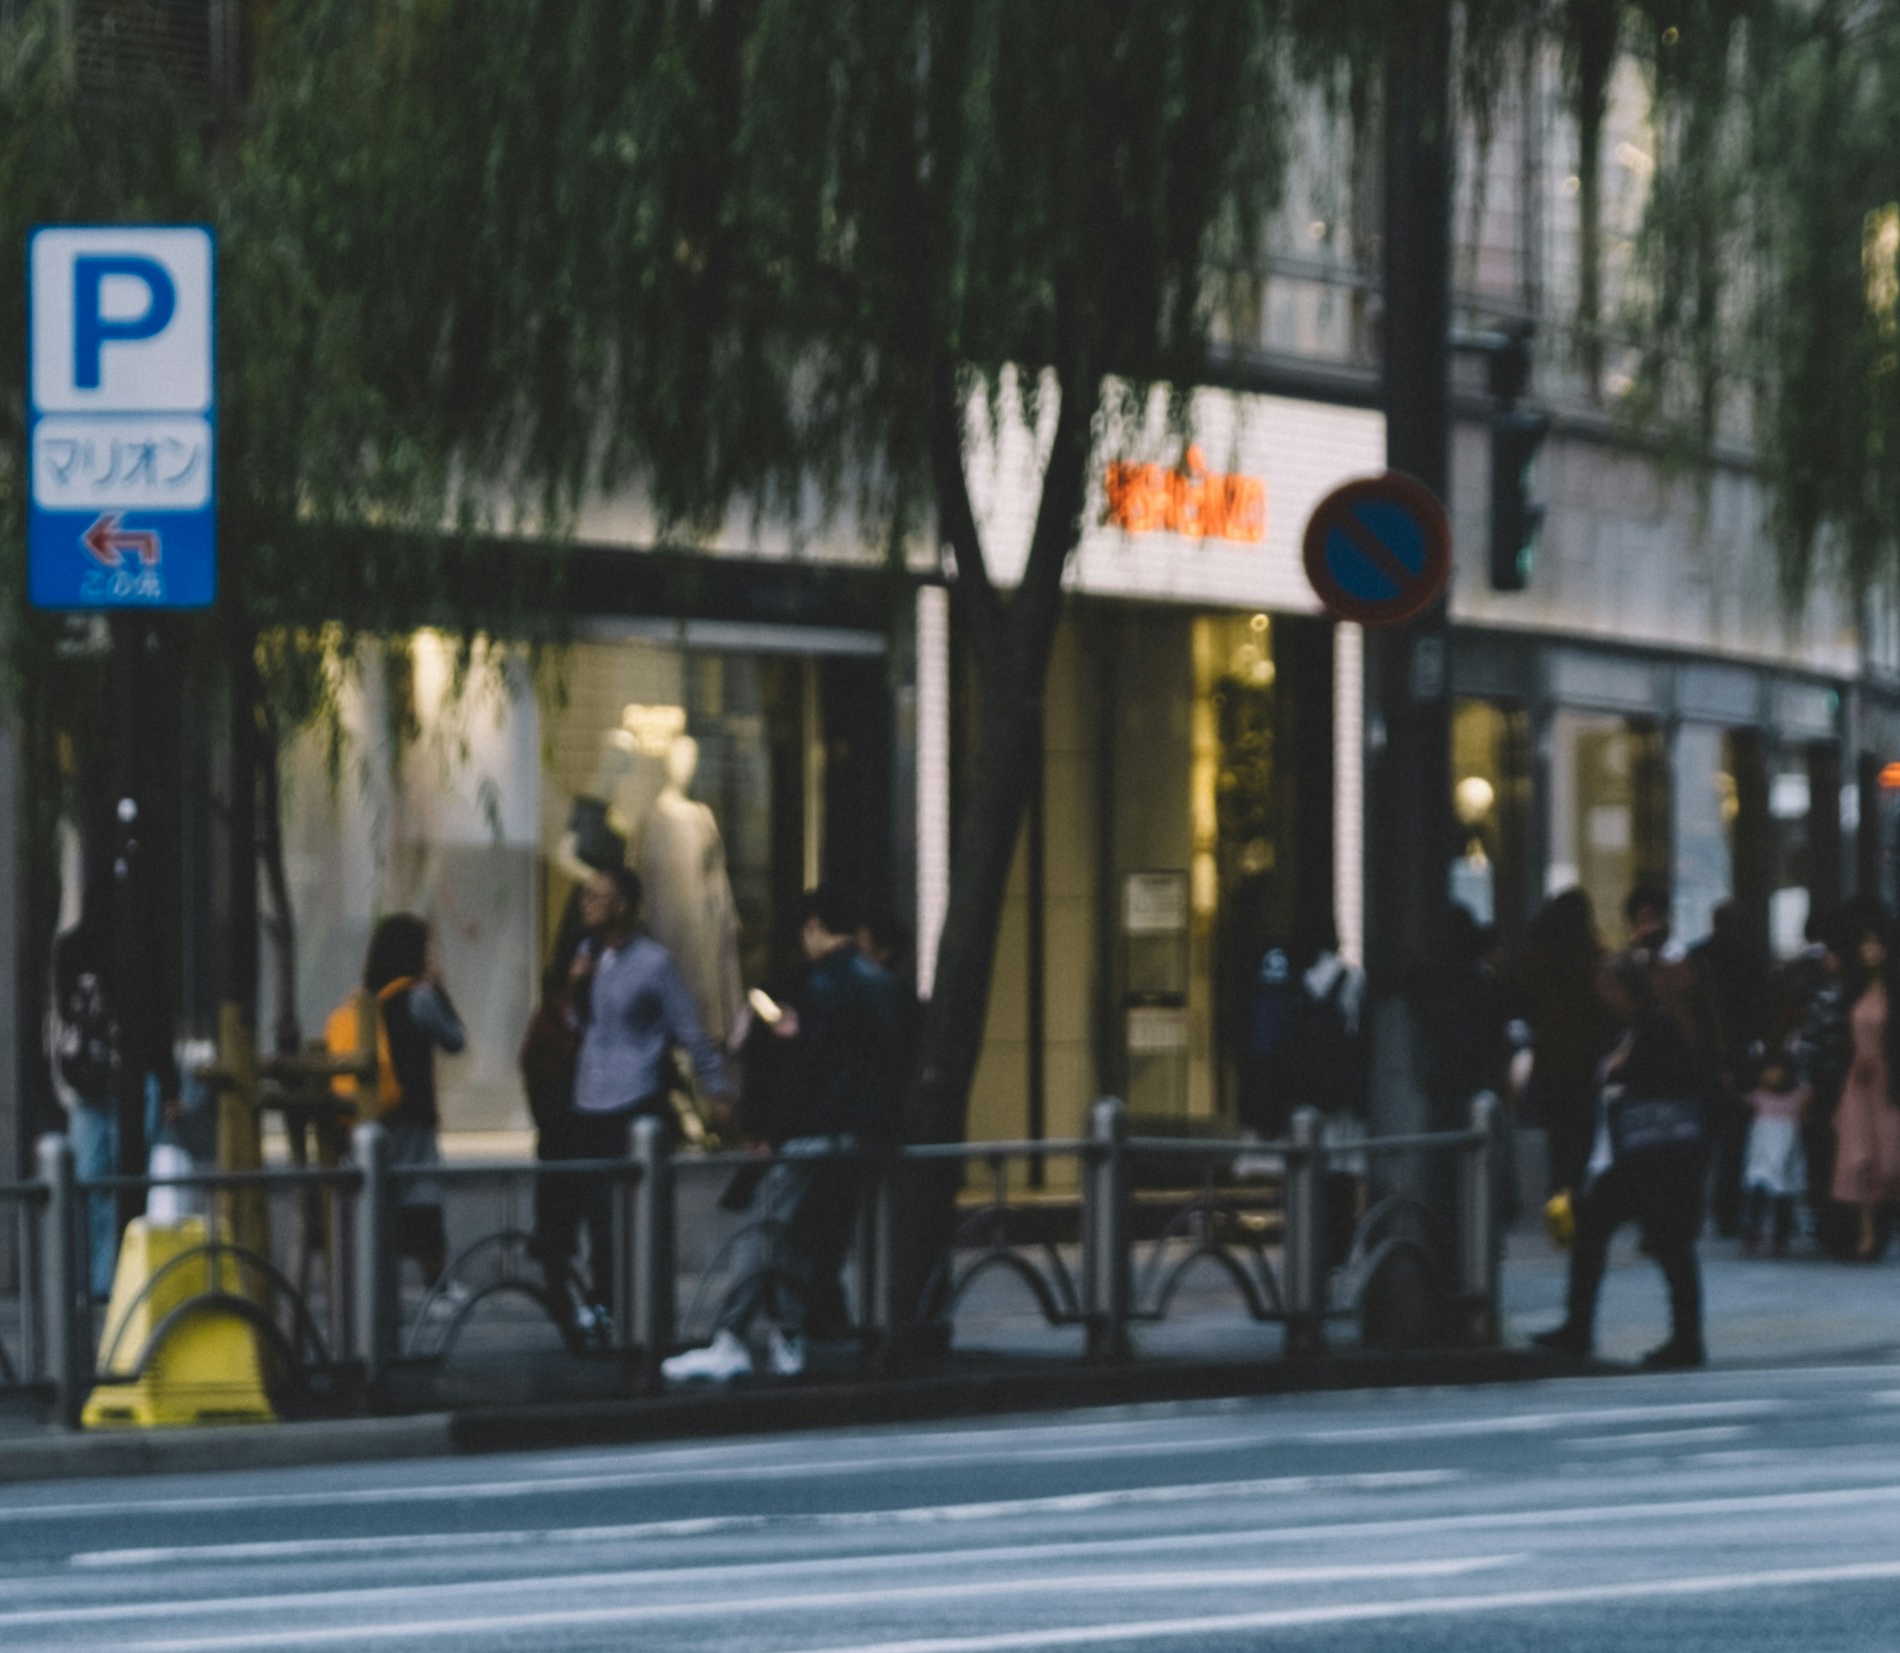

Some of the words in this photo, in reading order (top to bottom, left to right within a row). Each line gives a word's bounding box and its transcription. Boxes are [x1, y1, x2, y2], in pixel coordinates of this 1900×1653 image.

[74, 256, 175, 389] P
[42, 437, 199, 487] マリオン
